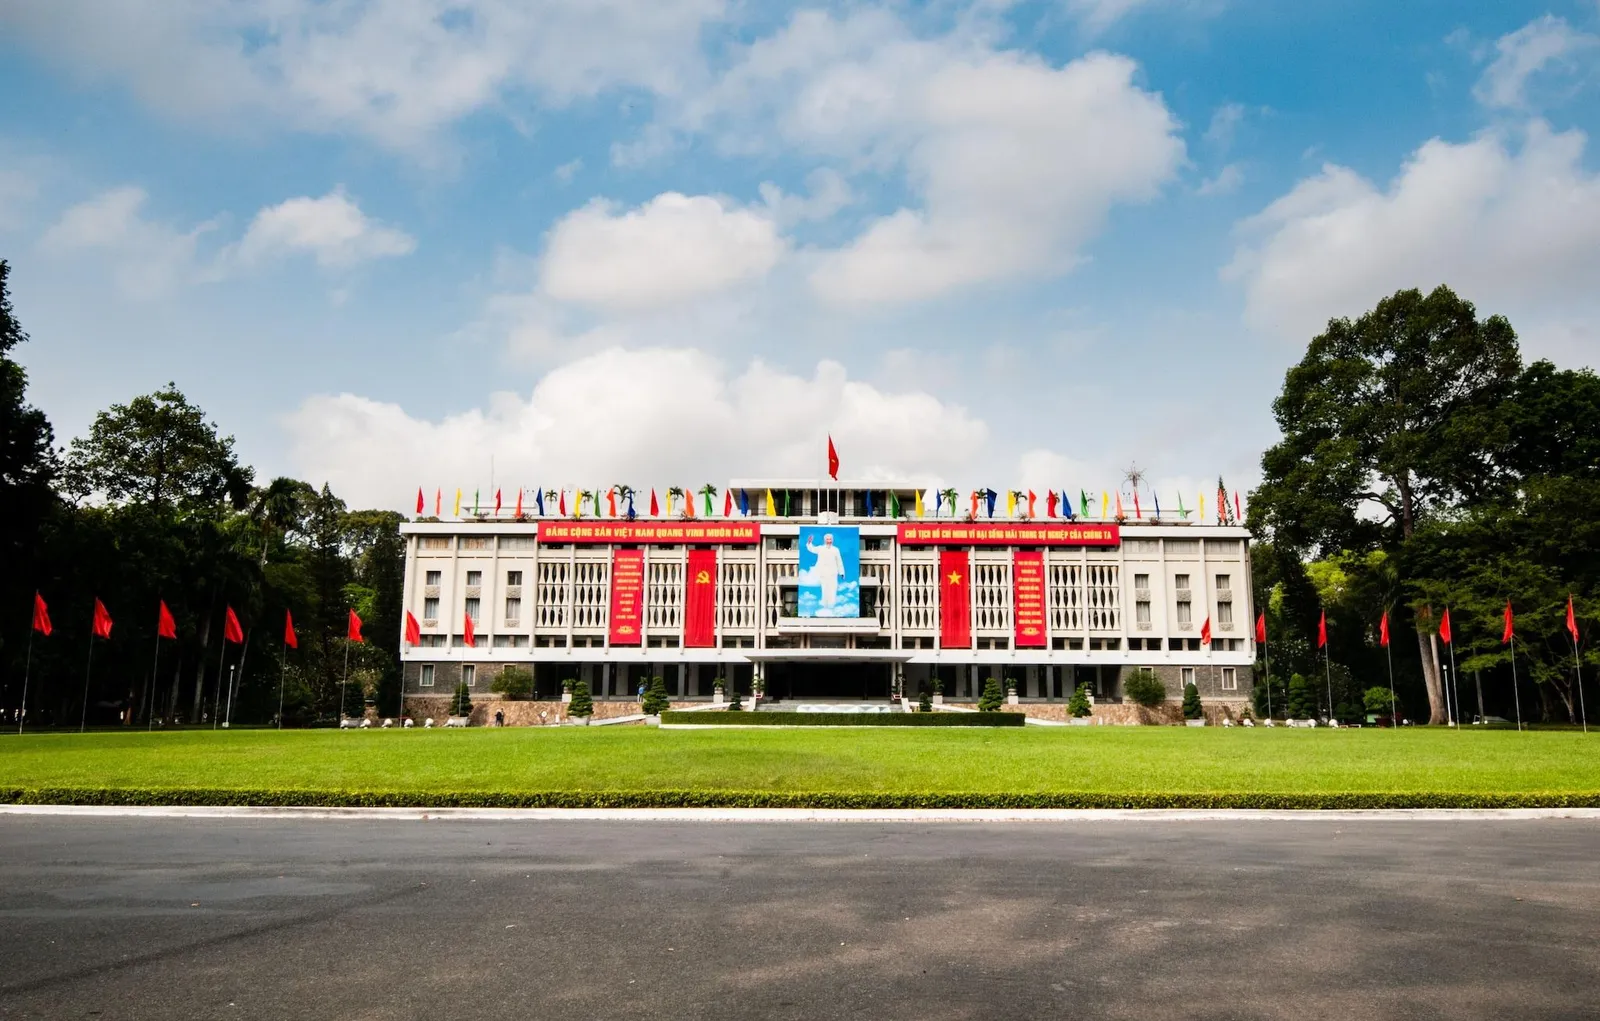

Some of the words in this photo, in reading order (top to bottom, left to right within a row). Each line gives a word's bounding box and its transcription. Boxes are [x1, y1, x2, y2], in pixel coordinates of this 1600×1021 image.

[614, 527, 633, 538] VIỆT
[635, 528, 655, 537] NAM
[656, 528, 683, 539] QUANG
[685, 528, 705, 537] VINH
[1103, 531, 1112, 540] TA
